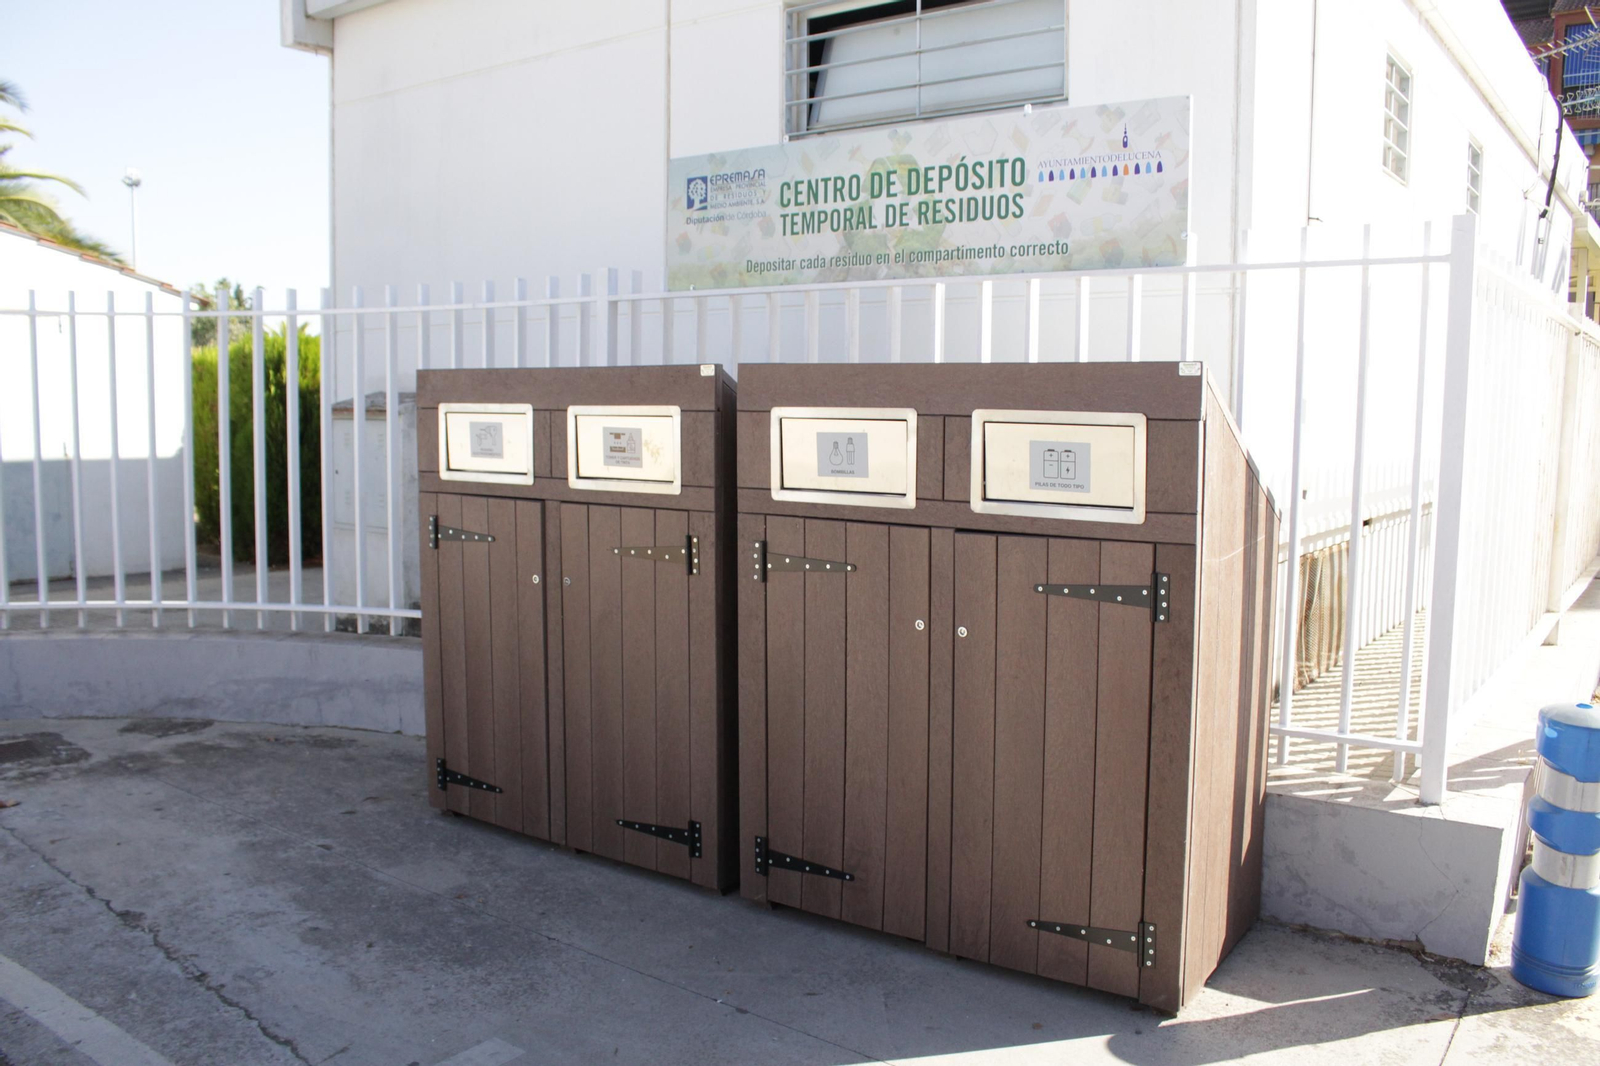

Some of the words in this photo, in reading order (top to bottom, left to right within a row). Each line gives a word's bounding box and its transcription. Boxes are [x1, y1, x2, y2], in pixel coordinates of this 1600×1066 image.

[710, 169, 766, 186] EPREMASA
[780, 174, 861, 208] CENTRO
[870, 170, 898, 199] DE
[907, 155, 1026, 196] DEPÓSITO
[686, 214, 725, 225] Diputación
[737, 210, 766, 220] Córdoba
[780, 205, 878, 237] TEMPORAL
[885, 202, 910, 228] DE
[917, 193, 1025, 226] RESIDUOS
[746, 257, 796, 275] Depositar
[800, 254, 826, 270] cada
[830, 251, 872, 267] residuo
[876, 252, 890, 264] en
[894, 249, 905, 263] el
[909, 243, 1005, 265] compartimento
[1010, 240, 1069, 258] correcto
